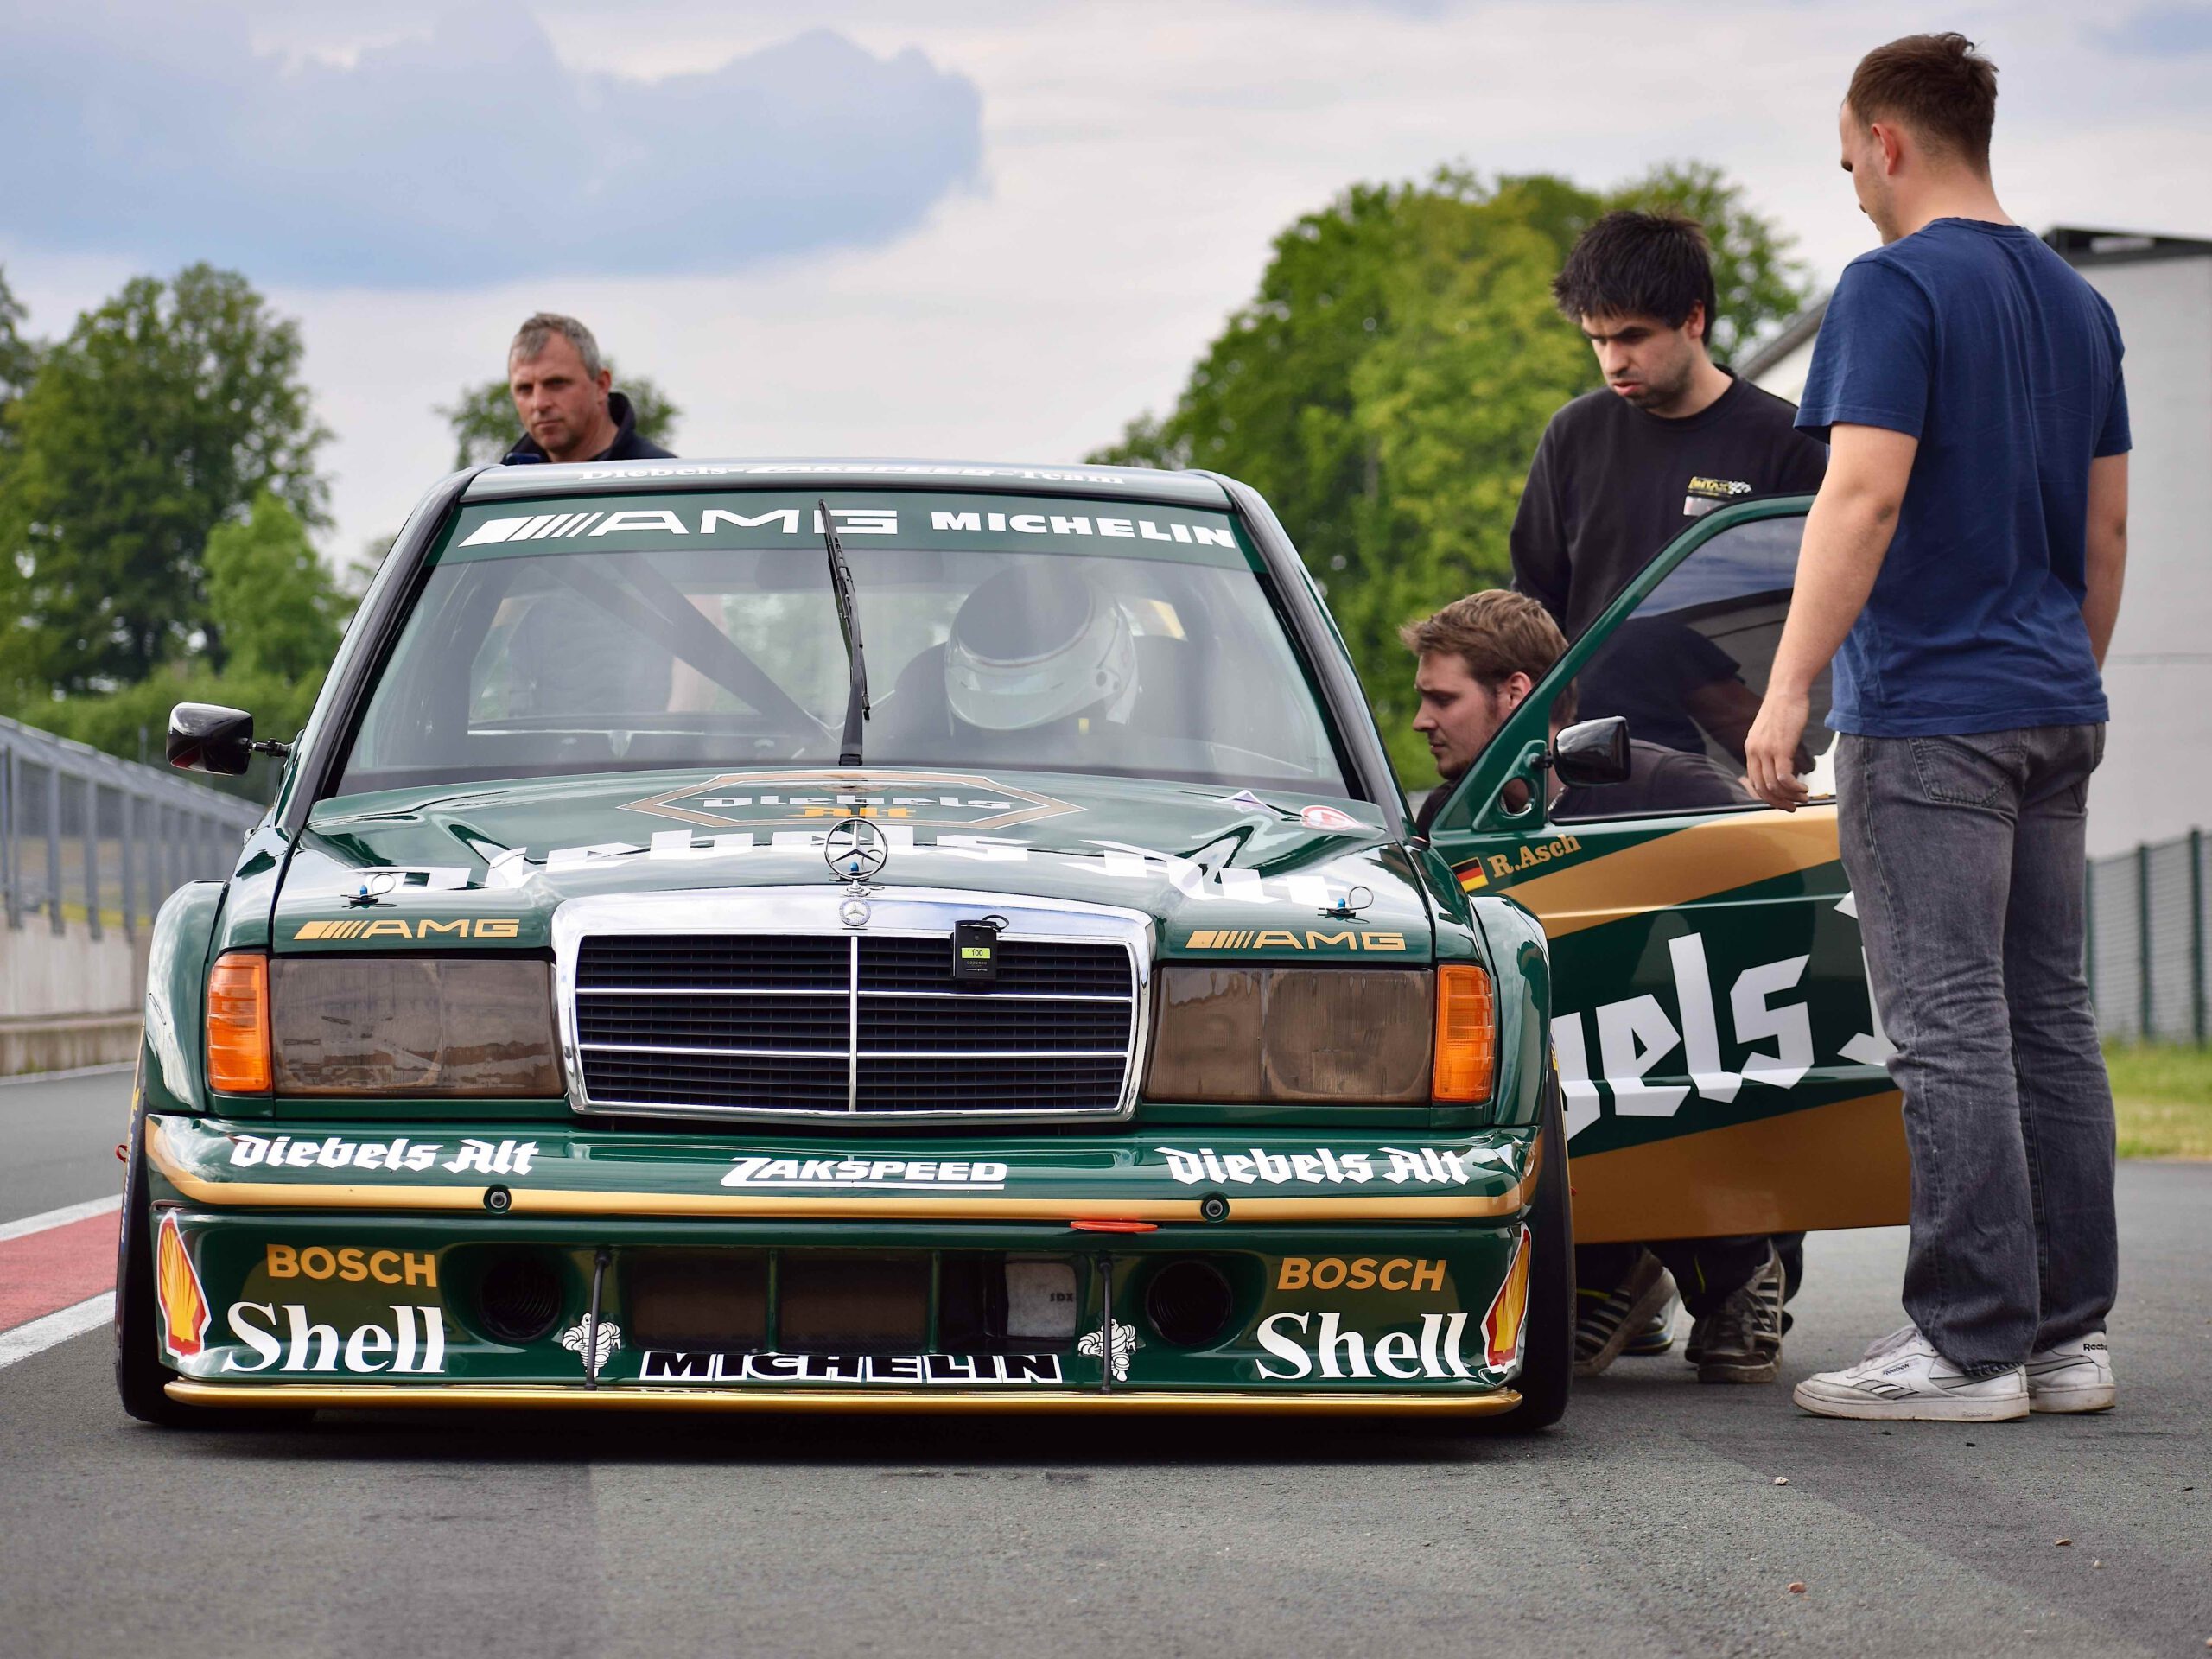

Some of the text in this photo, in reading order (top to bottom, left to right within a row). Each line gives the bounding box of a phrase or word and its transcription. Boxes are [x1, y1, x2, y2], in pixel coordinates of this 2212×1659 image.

[588, 509, 1236, 548] AMG MICHELIN
[1487, 834, 1581, 878] R.Asch
[360, 918, 519, 939] AMG
[1252, 930, 1407, 950] AMG
[227, 1135, 539, 1175] Diebels Alt
[721, 1157, 1007, 1190] ZAKSPEED
[1154, 1147, 1471, 1185] Diebels Alt
[266, 1243, 437, 1287] BOSCH
[1277, 1258, 1447, 1292] BOSCH
[221, 1302, 446, 1374] Shell
[1255, 1312, 1478, 1380] Shell
[639, 1351, 1064, 1385] MICHELIN
